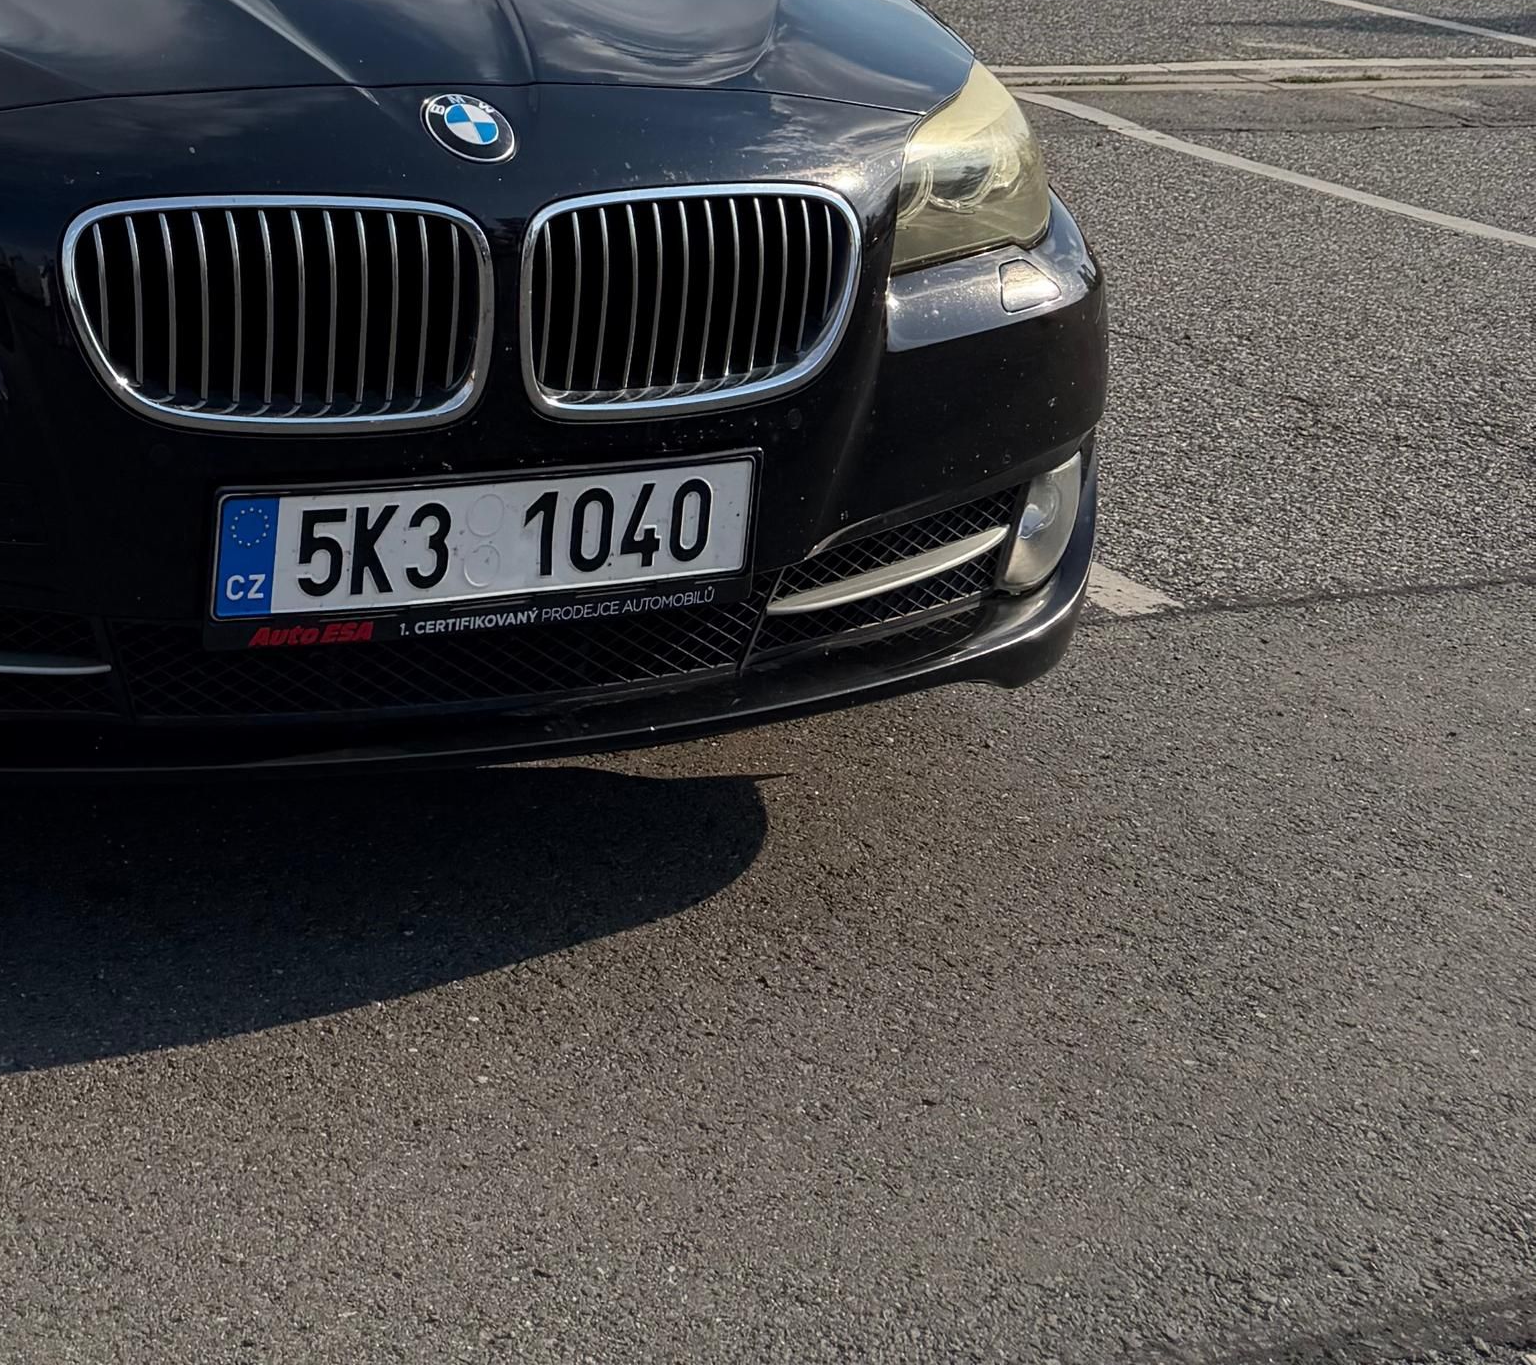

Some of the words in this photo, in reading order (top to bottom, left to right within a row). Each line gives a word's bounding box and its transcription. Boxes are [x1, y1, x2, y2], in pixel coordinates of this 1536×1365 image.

[430, 94, 495, 116] BMW
[297, 502, 453, 598] 5K3
[524, 477, 713, 577] 1040
[225, 573, 265, 602] CZ
[399, 622, 411, 637] 1.
[414, 607, 538, 635] CERTIFIKOVANÝ
[541, 600, 620, 622] PRODEJCE
[622, 585, 715, 614] AUTOMOBILŮ
[248, 626, 319, 647] Auto
[320, 621, 375, 643] ESA
